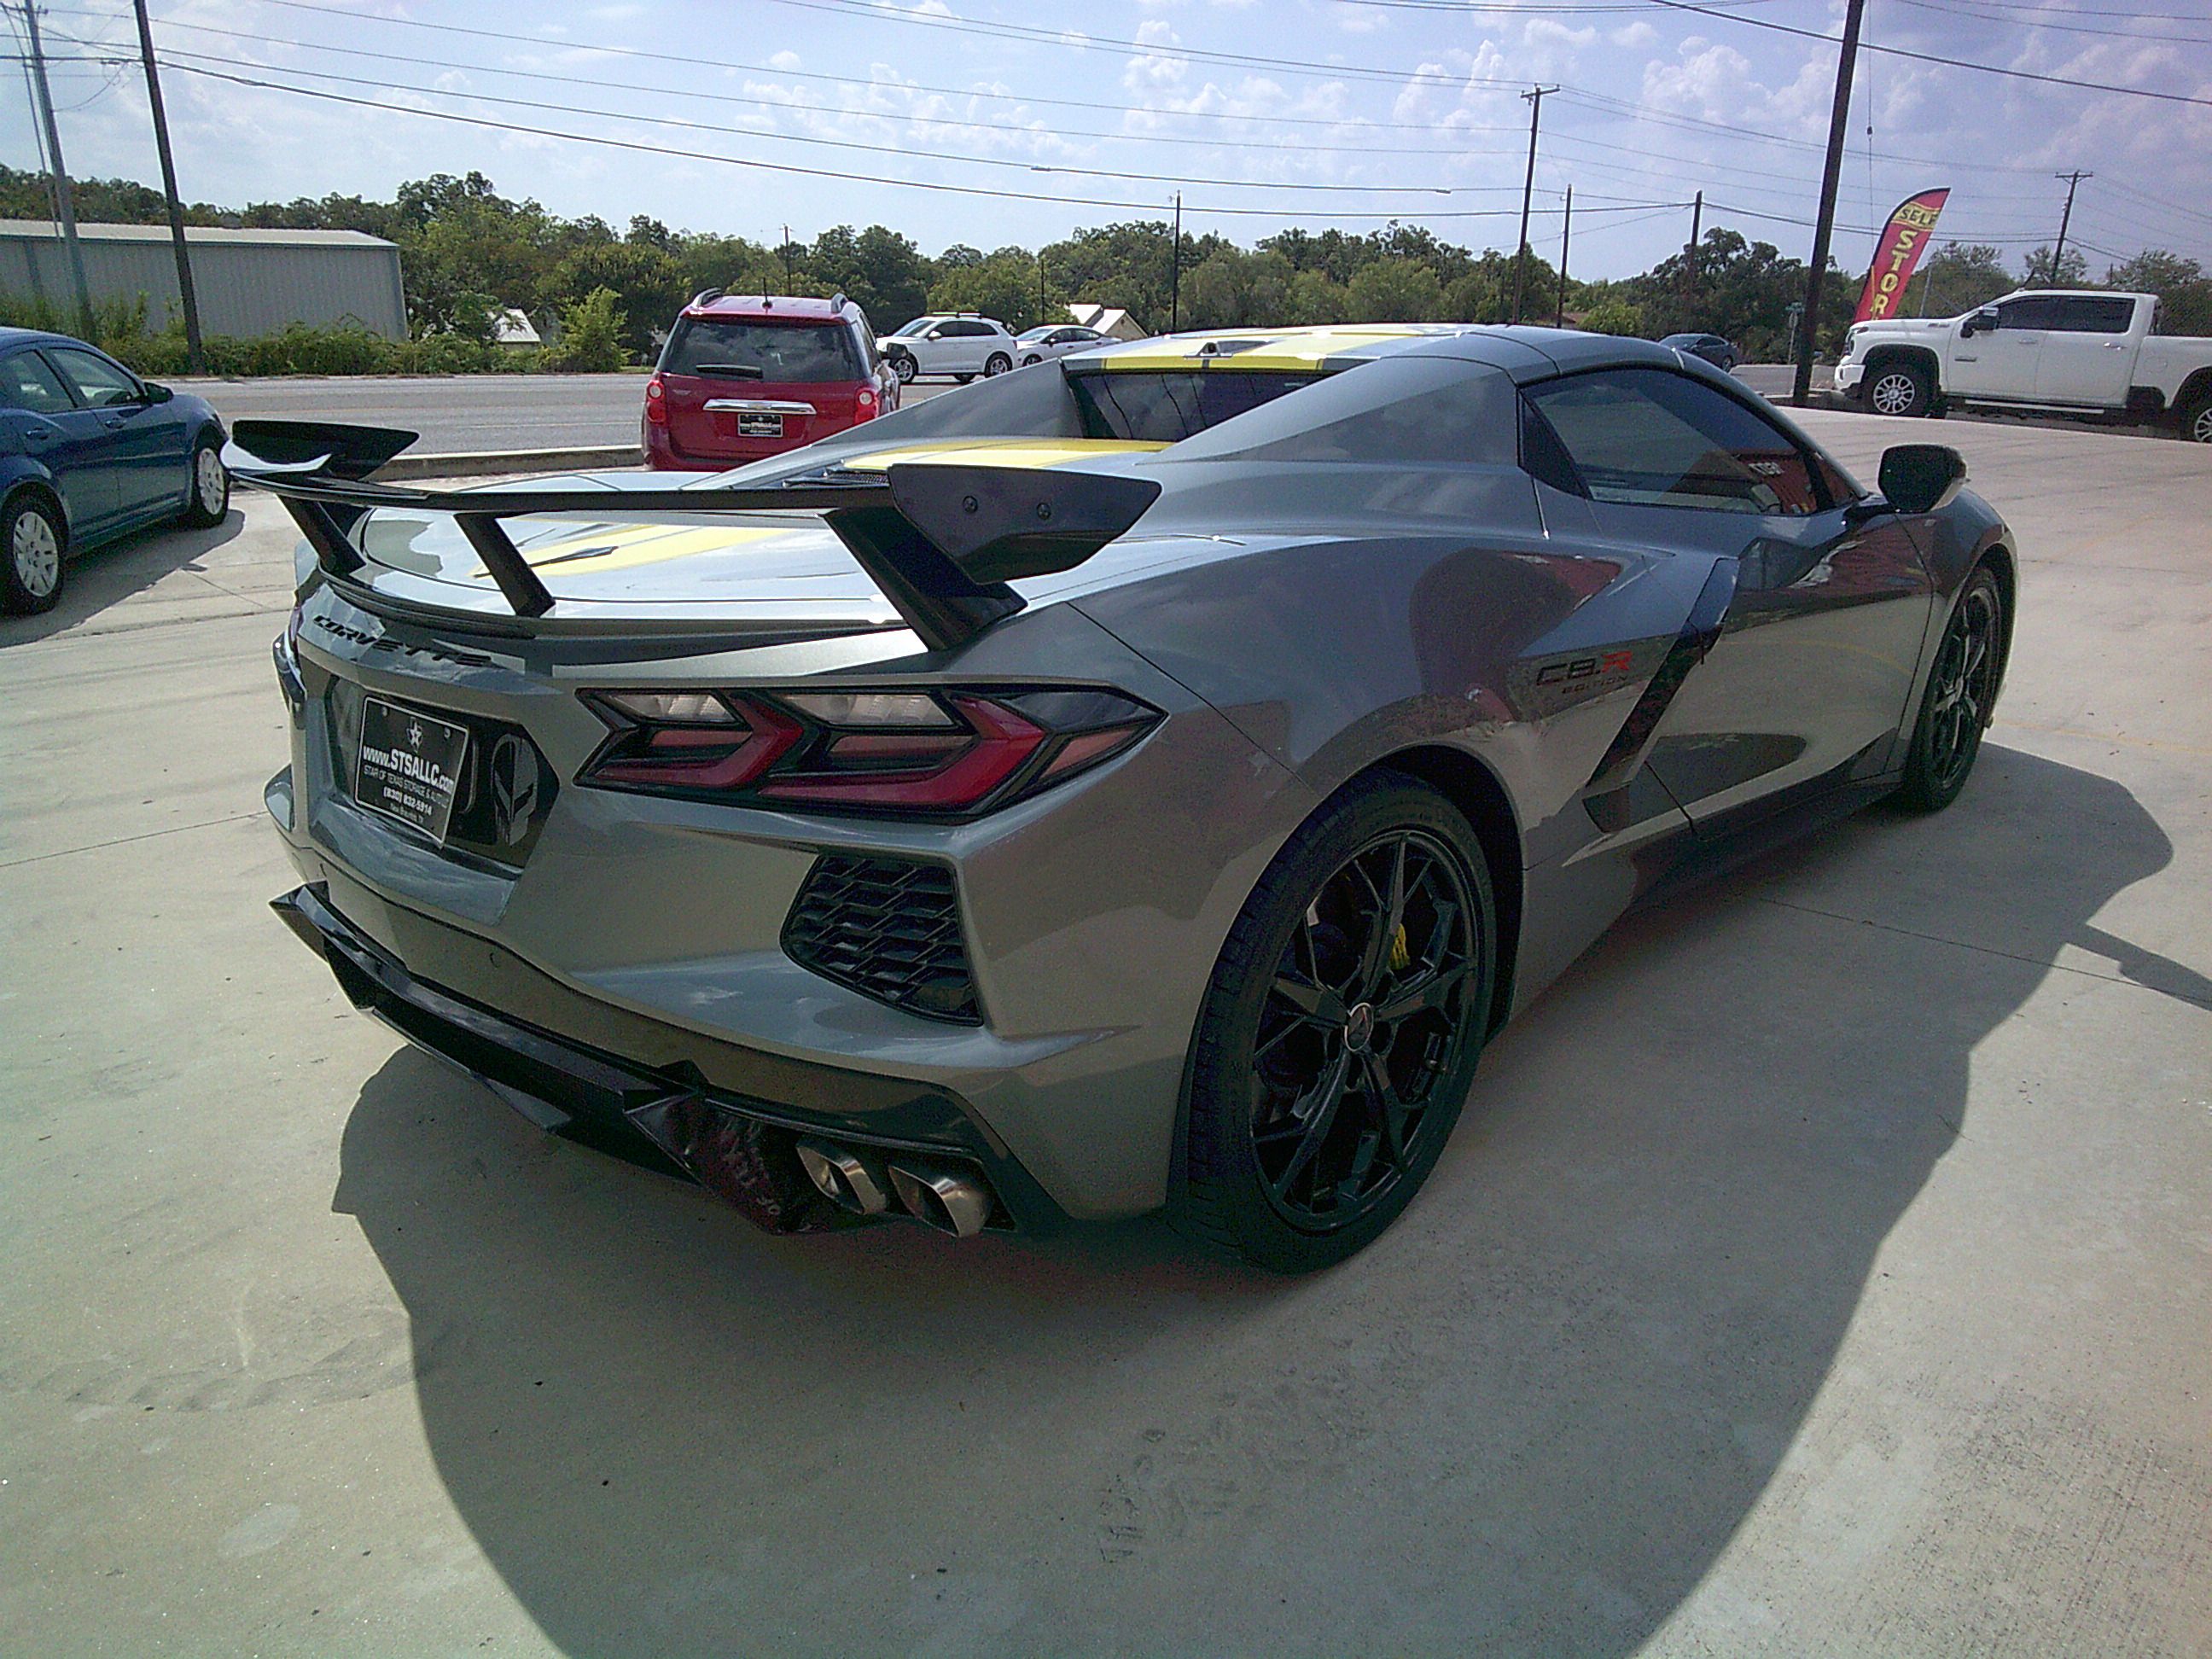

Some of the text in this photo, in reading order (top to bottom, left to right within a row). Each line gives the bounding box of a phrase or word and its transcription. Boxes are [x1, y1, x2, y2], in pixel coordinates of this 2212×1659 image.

[1901, 208, 1939, 225] SELF
[1871, 230, 1918, 320] STOR
[313, 615, 492, 666] CORVETTE
